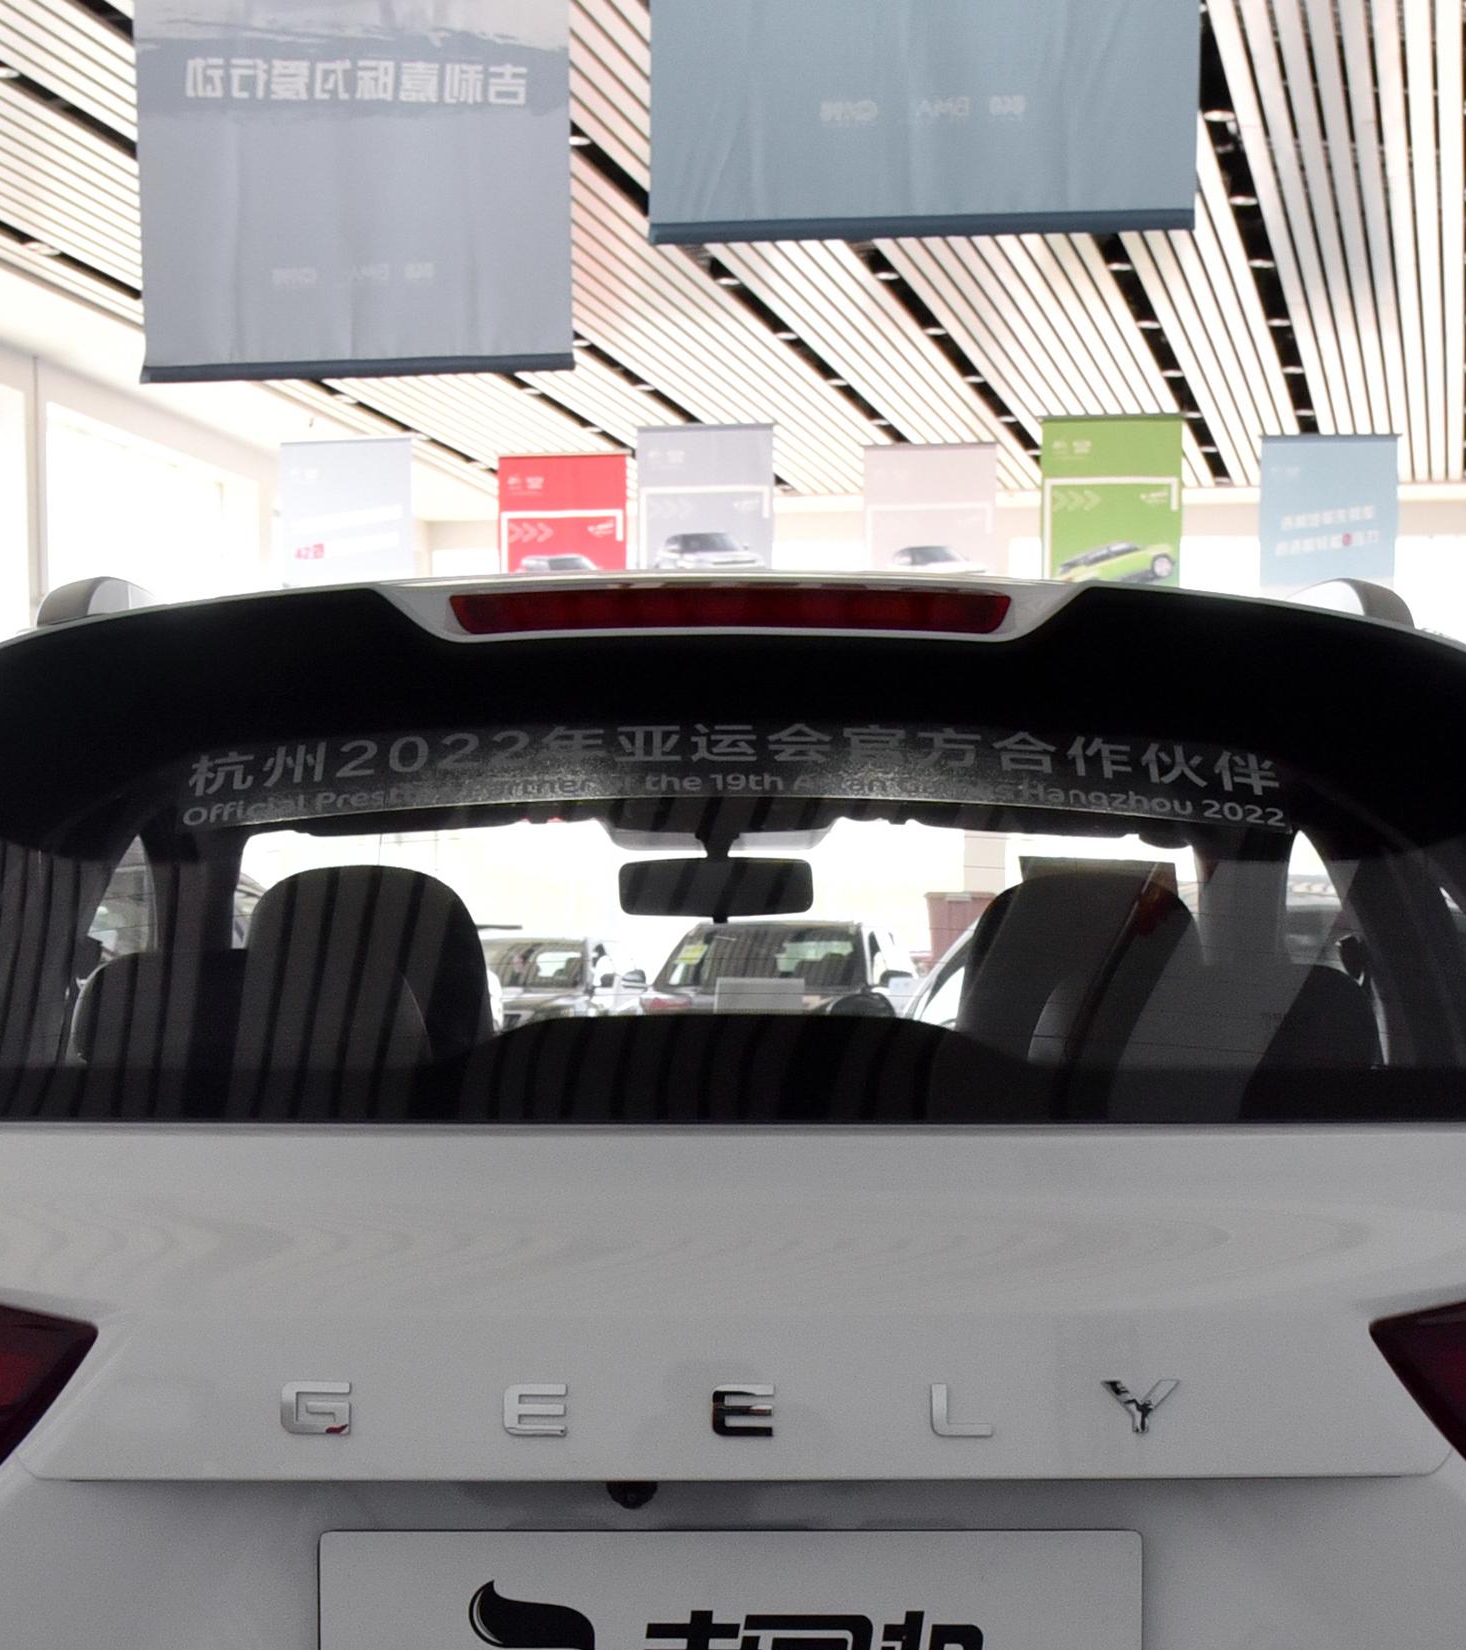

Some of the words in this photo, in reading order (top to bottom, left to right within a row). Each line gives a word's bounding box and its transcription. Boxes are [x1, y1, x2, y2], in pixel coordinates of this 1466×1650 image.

[188, 722, 1280, 797] 杭州2022年亚运会官方合作伙伴
[182, 795, 305, 827] Official
[645, 772, 702, 792] the
[708, 772, 784, 792] 19th
[1023, 780, 1193, 816] Hangzhou
[1202, 799, 1286, 828] 2022
[280, 1378, 1182, 1437] GEELY
